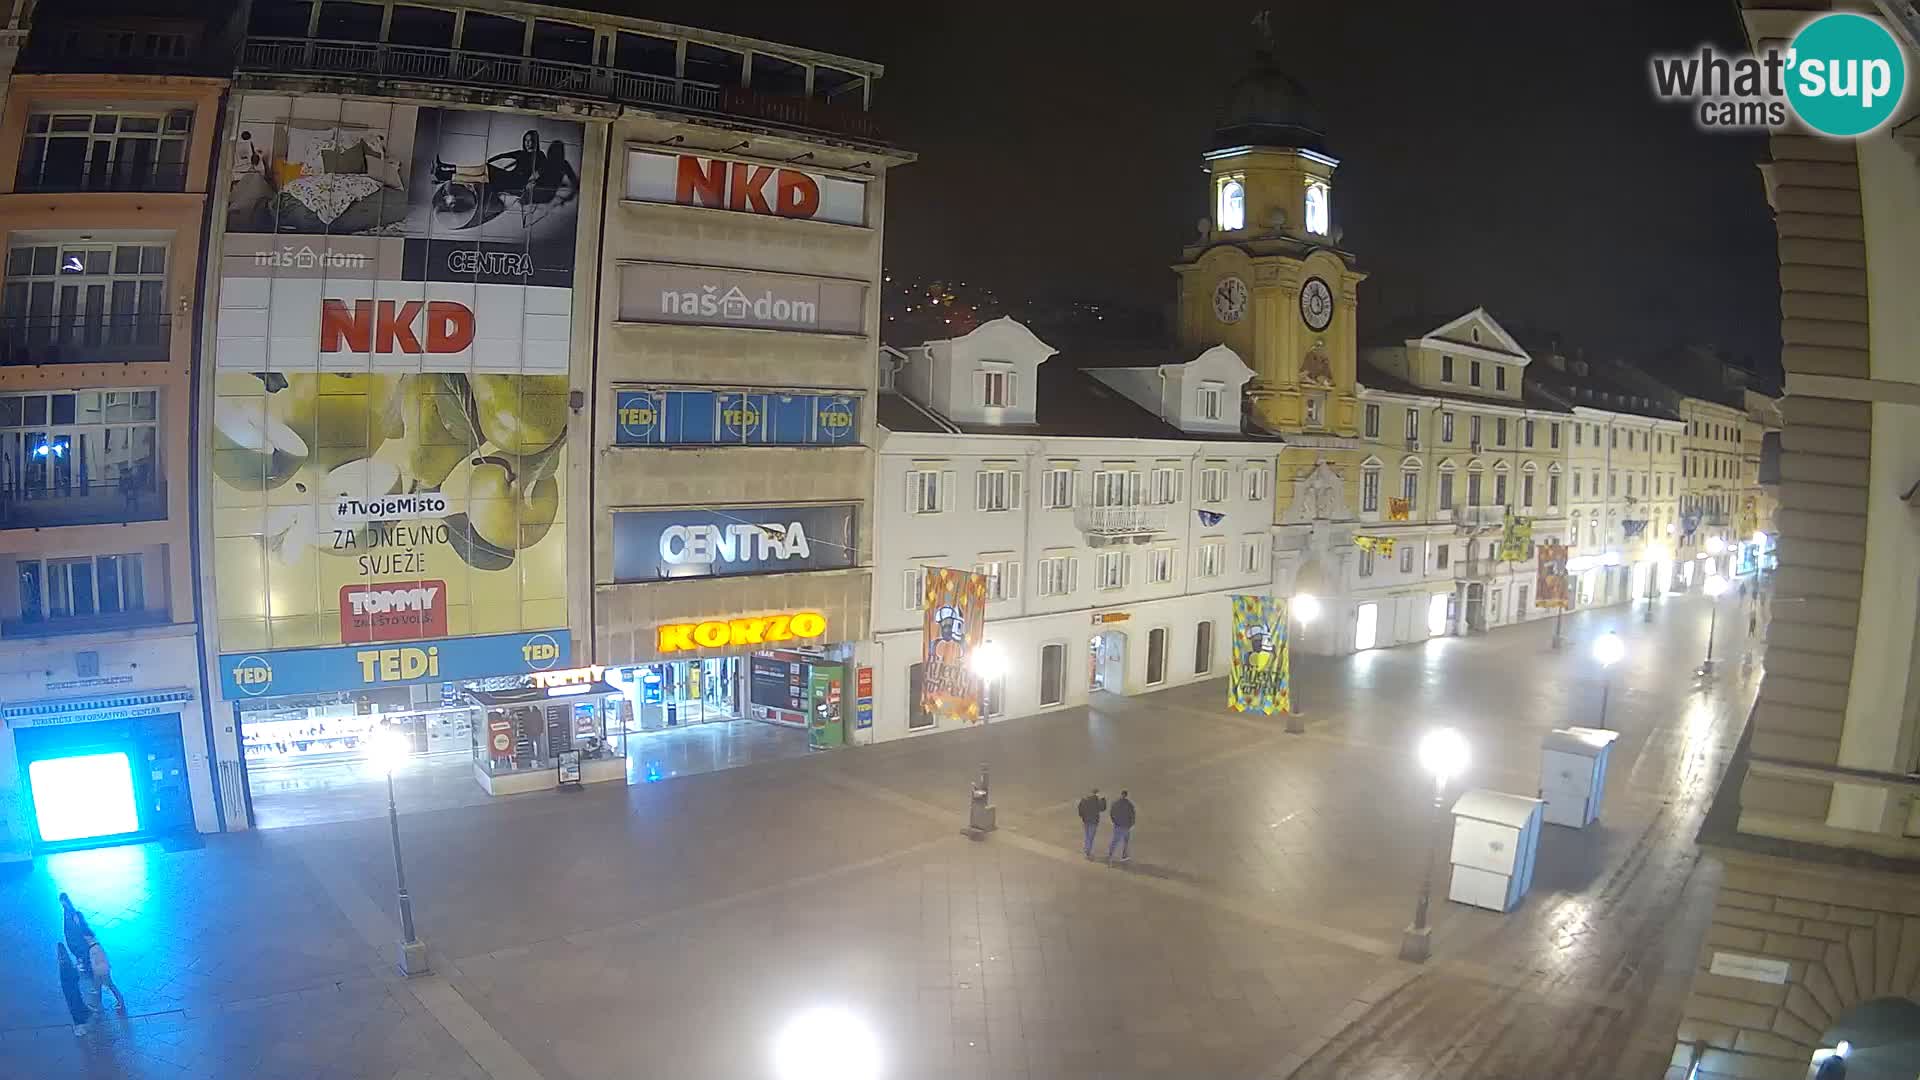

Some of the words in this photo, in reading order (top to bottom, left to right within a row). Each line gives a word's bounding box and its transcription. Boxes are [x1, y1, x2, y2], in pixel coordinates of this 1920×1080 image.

[676, 155, 820, 219] NKD
[255, 246, 293, 268] naš
[318, 246, 365, 269] dom
[447, 250, 534, 276] CENTRA
[661, 285, 717, 317] naš
[753, 291, 816, 323] dom
[319, 298, 477, 354] NKD
[618, 408, 657, 426] TEDi
[723, 409, 759, 426] TEDi
[819, 411, 852, 427] TEDi
[337, 497, 445, 517] #TvojeMisto
[333, 529, 357, 550] ZA
[368, 524, 449, 548] DNEVNO
[660, 521, 810, 564] CENTRA
[359, 548, 425, 576] SVJEŽE
[347, 587, 439, 615] TOMMY
[657, 612, 827, 652] KORZO
[356, 646, 439, 683] TEDi
[521, 642, 560, 662] TEDi
[232, 665, 272, 685] TEDi
